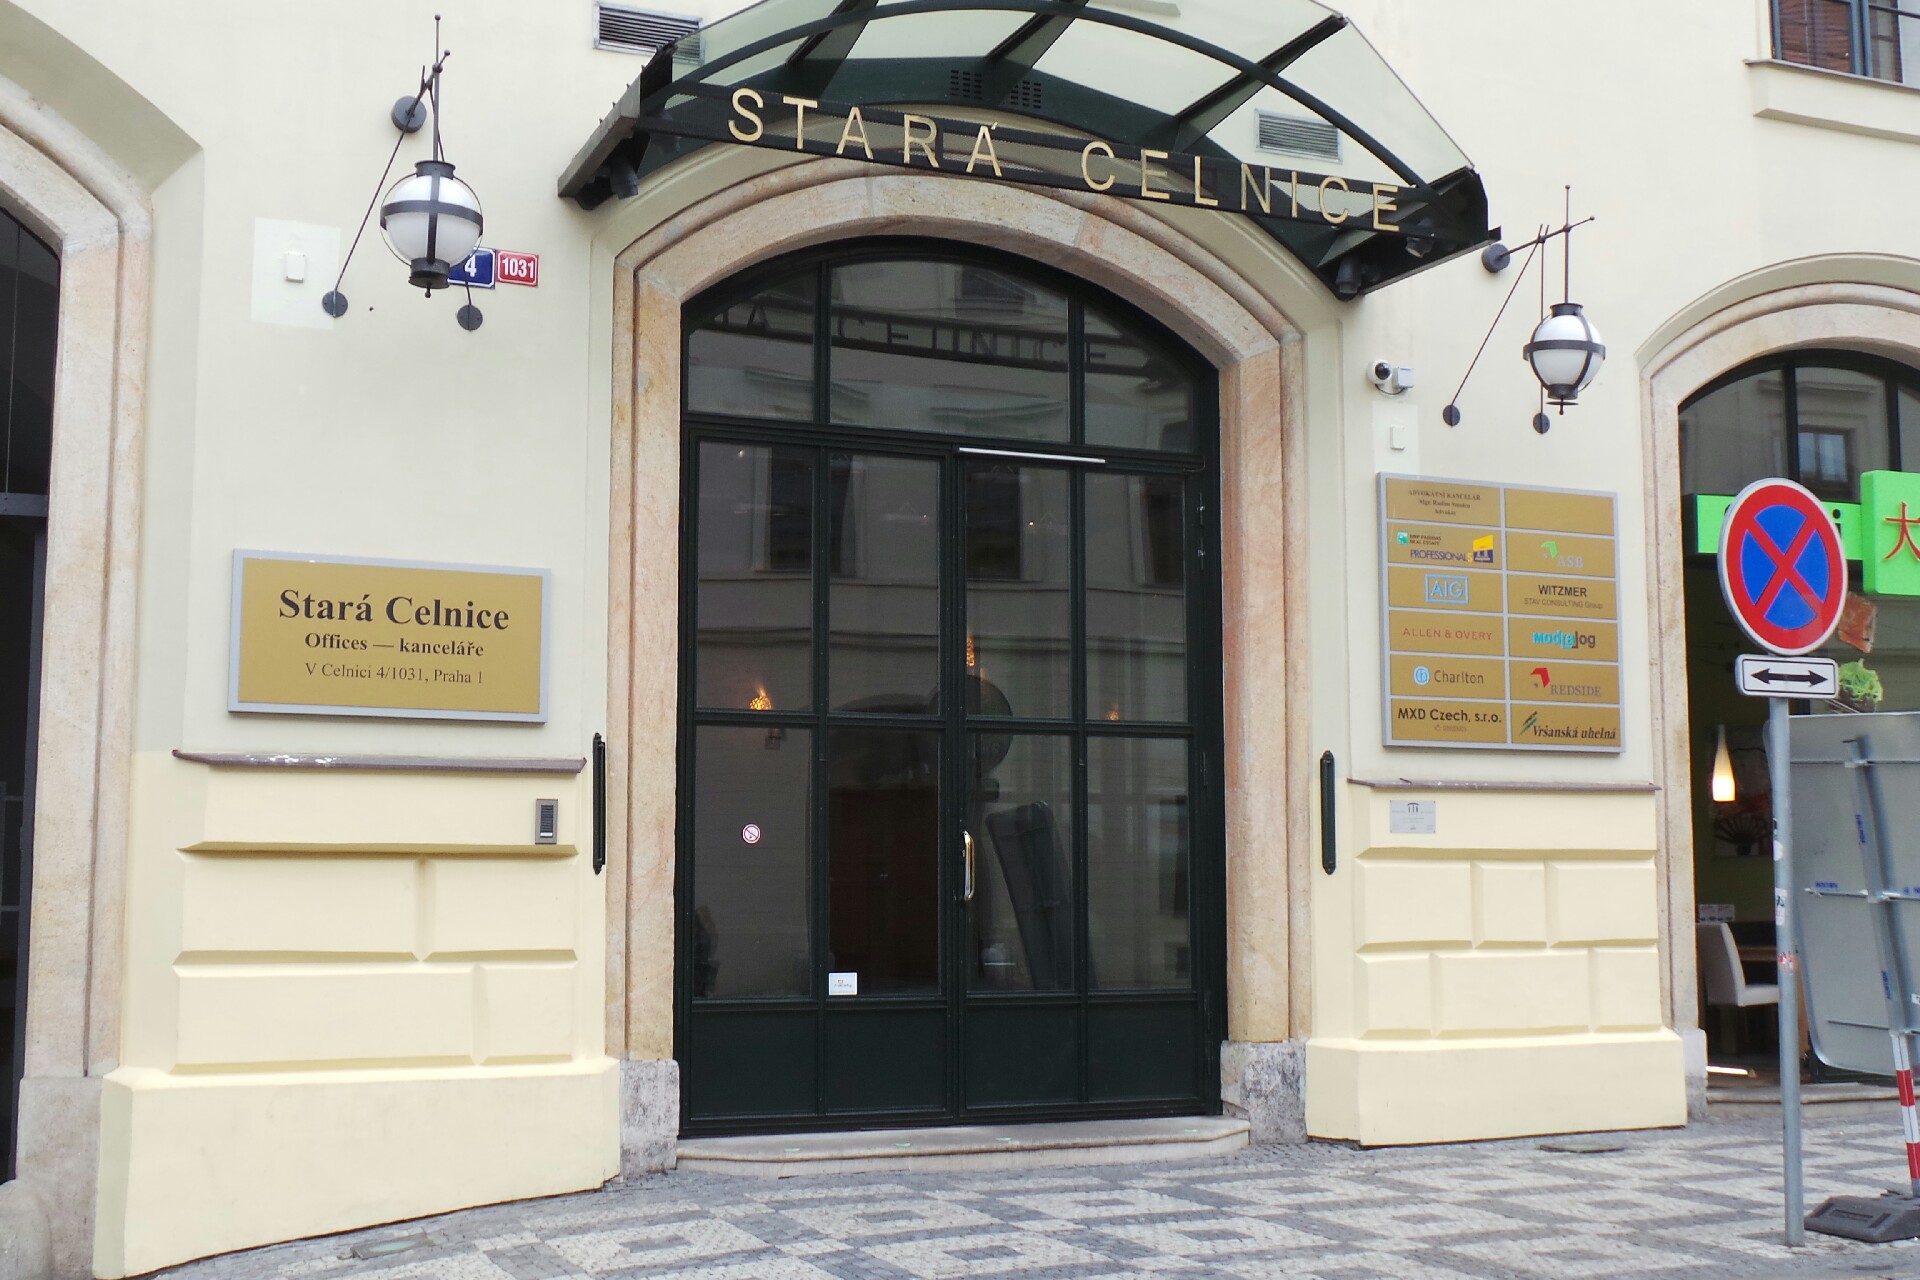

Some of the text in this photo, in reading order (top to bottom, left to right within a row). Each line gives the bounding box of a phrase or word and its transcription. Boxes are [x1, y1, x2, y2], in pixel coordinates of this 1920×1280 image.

[727, 87, 1402, 232] STARÁ CELNICE
[502, 257, 534, 279] 1031
[1431, 580, 1464, 598] AIG
[1538, 585, 1588, 597] WITZMER
[278, 588, 509, 630] Stará Celnice
[1402, 627, 1492, 641] ALLEN & OVERY
[304, 632, 368, 651] Offices
[399, 638, 484, 657] kanceláře
[305, 662, 483, 684] V Celnici 4/1031, Praha 1
[1433, 670, 1484, 685] Charlton
[1550, 684, 1601, 697] REDSIDE
[1397, 707, 1502, 724] MXD Czech, s.r.o.
[1533, 724, 1617, 740] Vršanská uhelná
